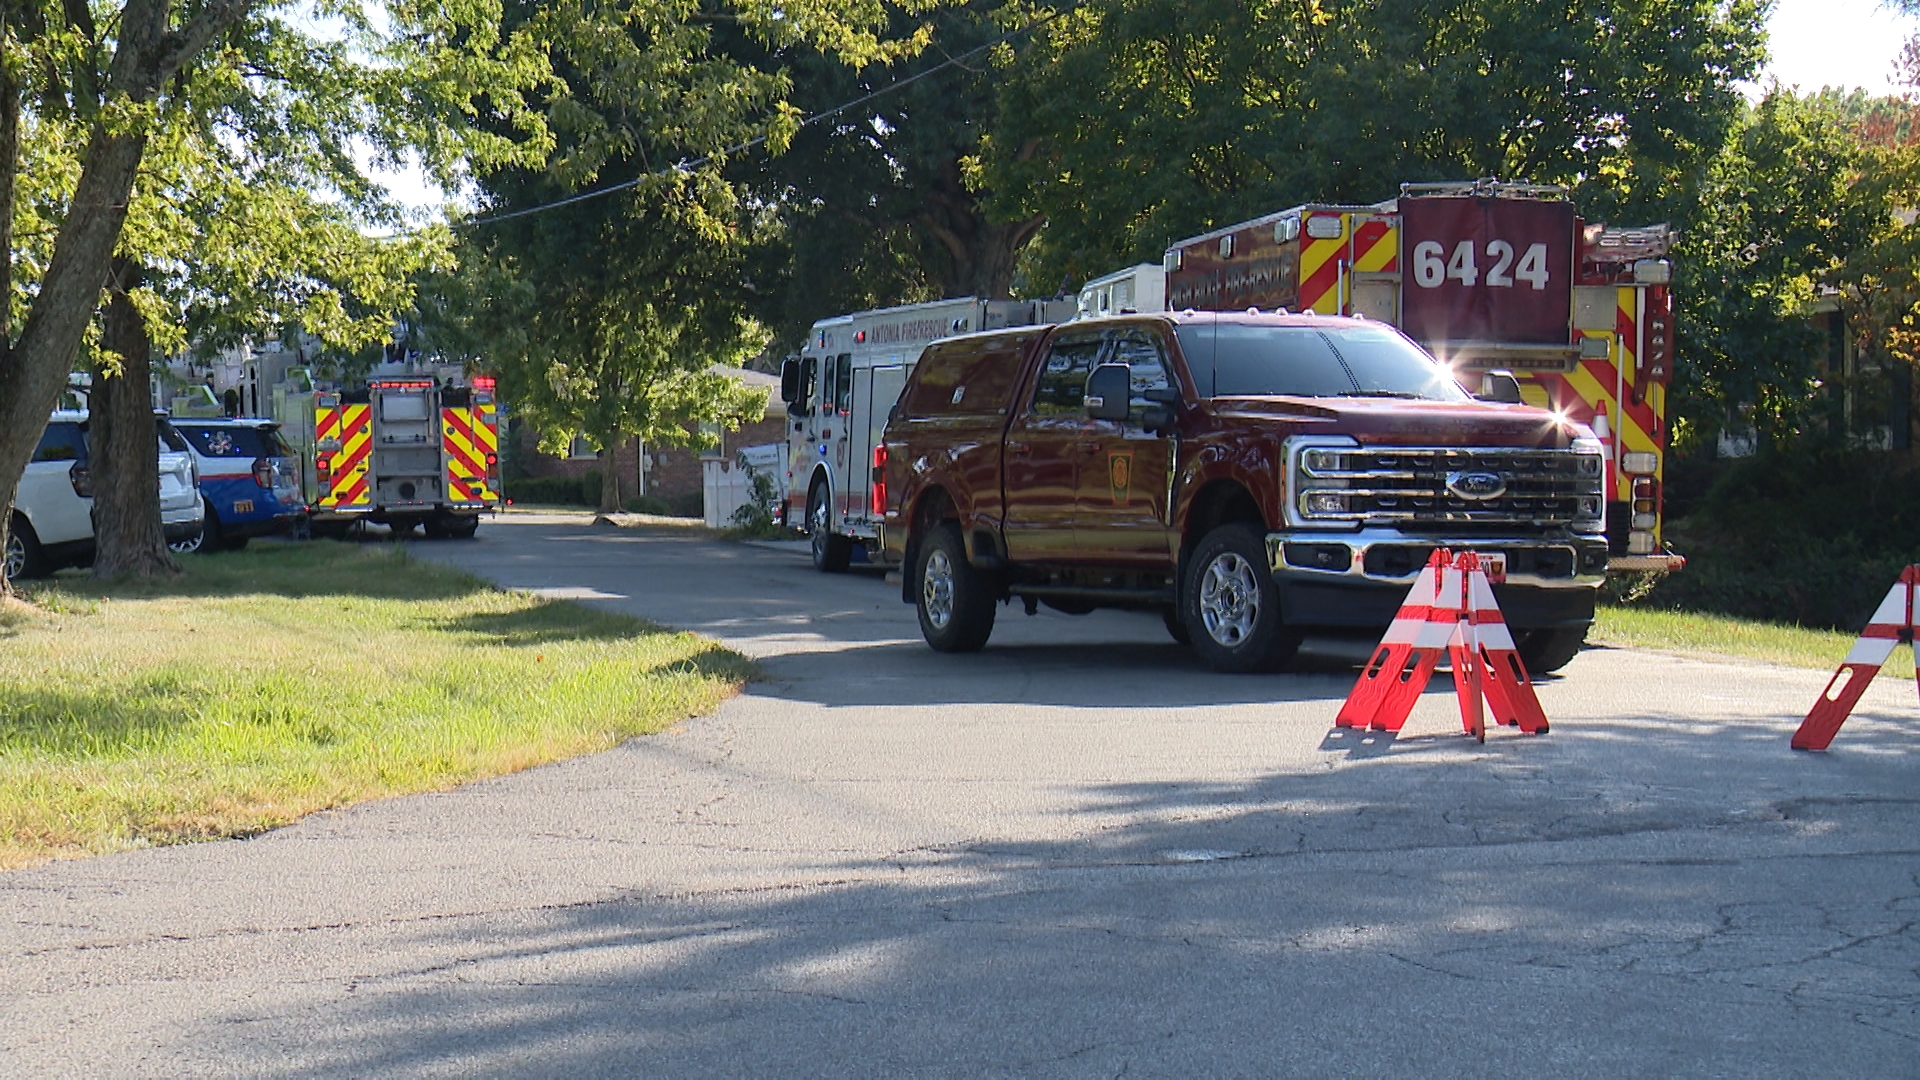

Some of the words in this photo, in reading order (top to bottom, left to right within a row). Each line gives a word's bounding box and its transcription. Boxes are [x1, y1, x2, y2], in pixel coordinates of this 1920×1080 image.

[1413, 239, 1549, 290] 6424
[871, 323, 899, 343] ANTONIA
[902, 318, 948, 341] FIRE/RESCUE
